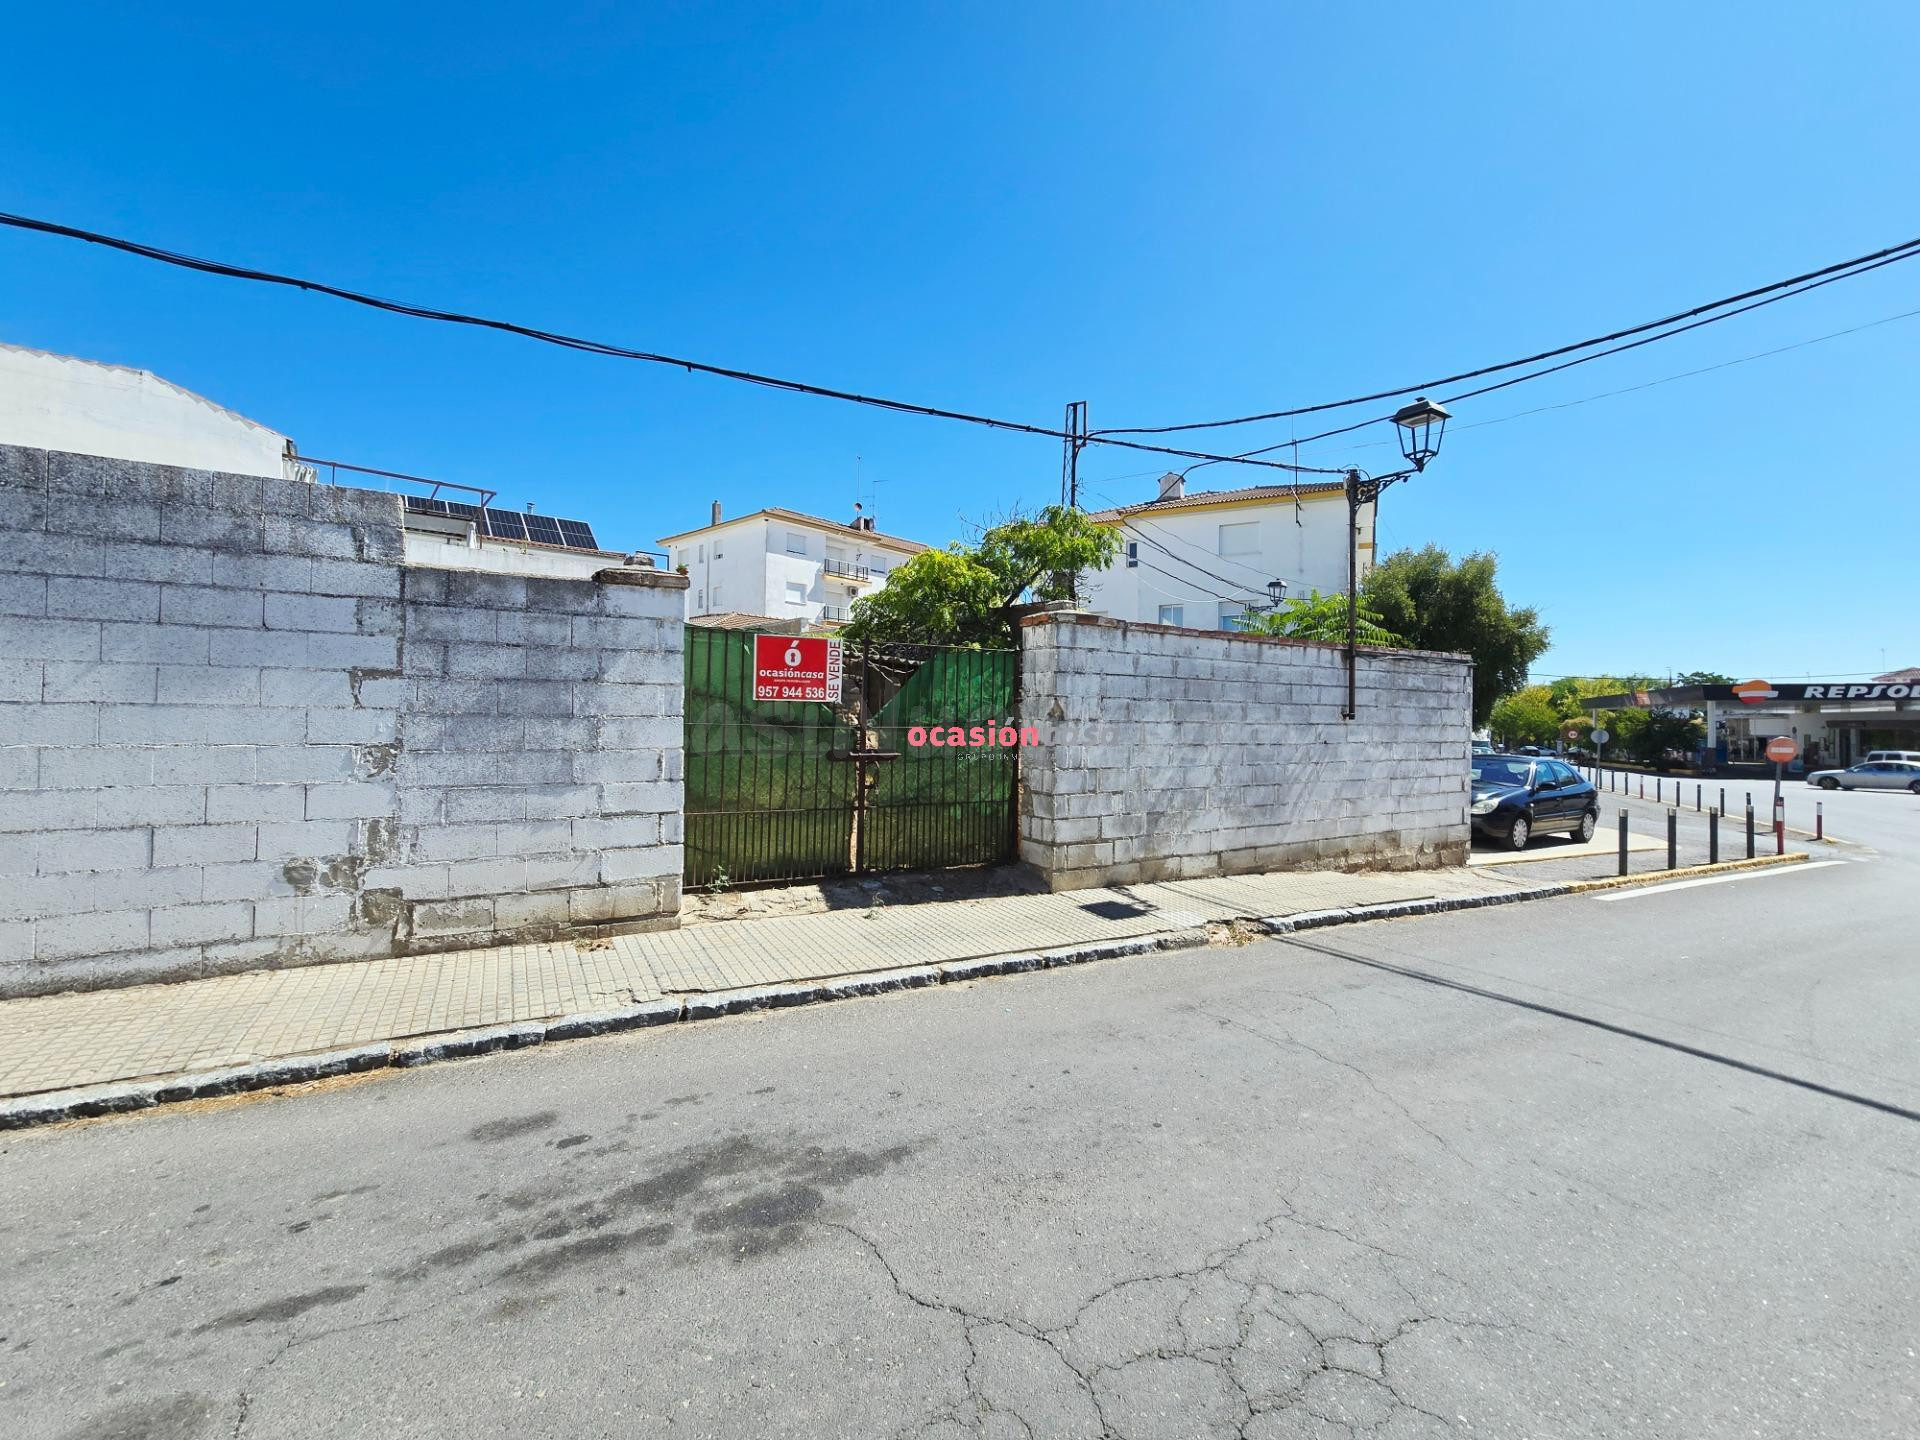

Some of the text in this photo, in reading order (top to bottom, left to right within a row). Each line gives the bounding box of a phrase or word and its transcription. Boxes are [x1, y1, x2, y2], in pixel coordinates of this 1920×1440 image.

[759, 668, 824, 679] ocasióncasa
[828, 641, 840, 698] SE VENDE
[758, 686, 824, 698] 957 944 536
